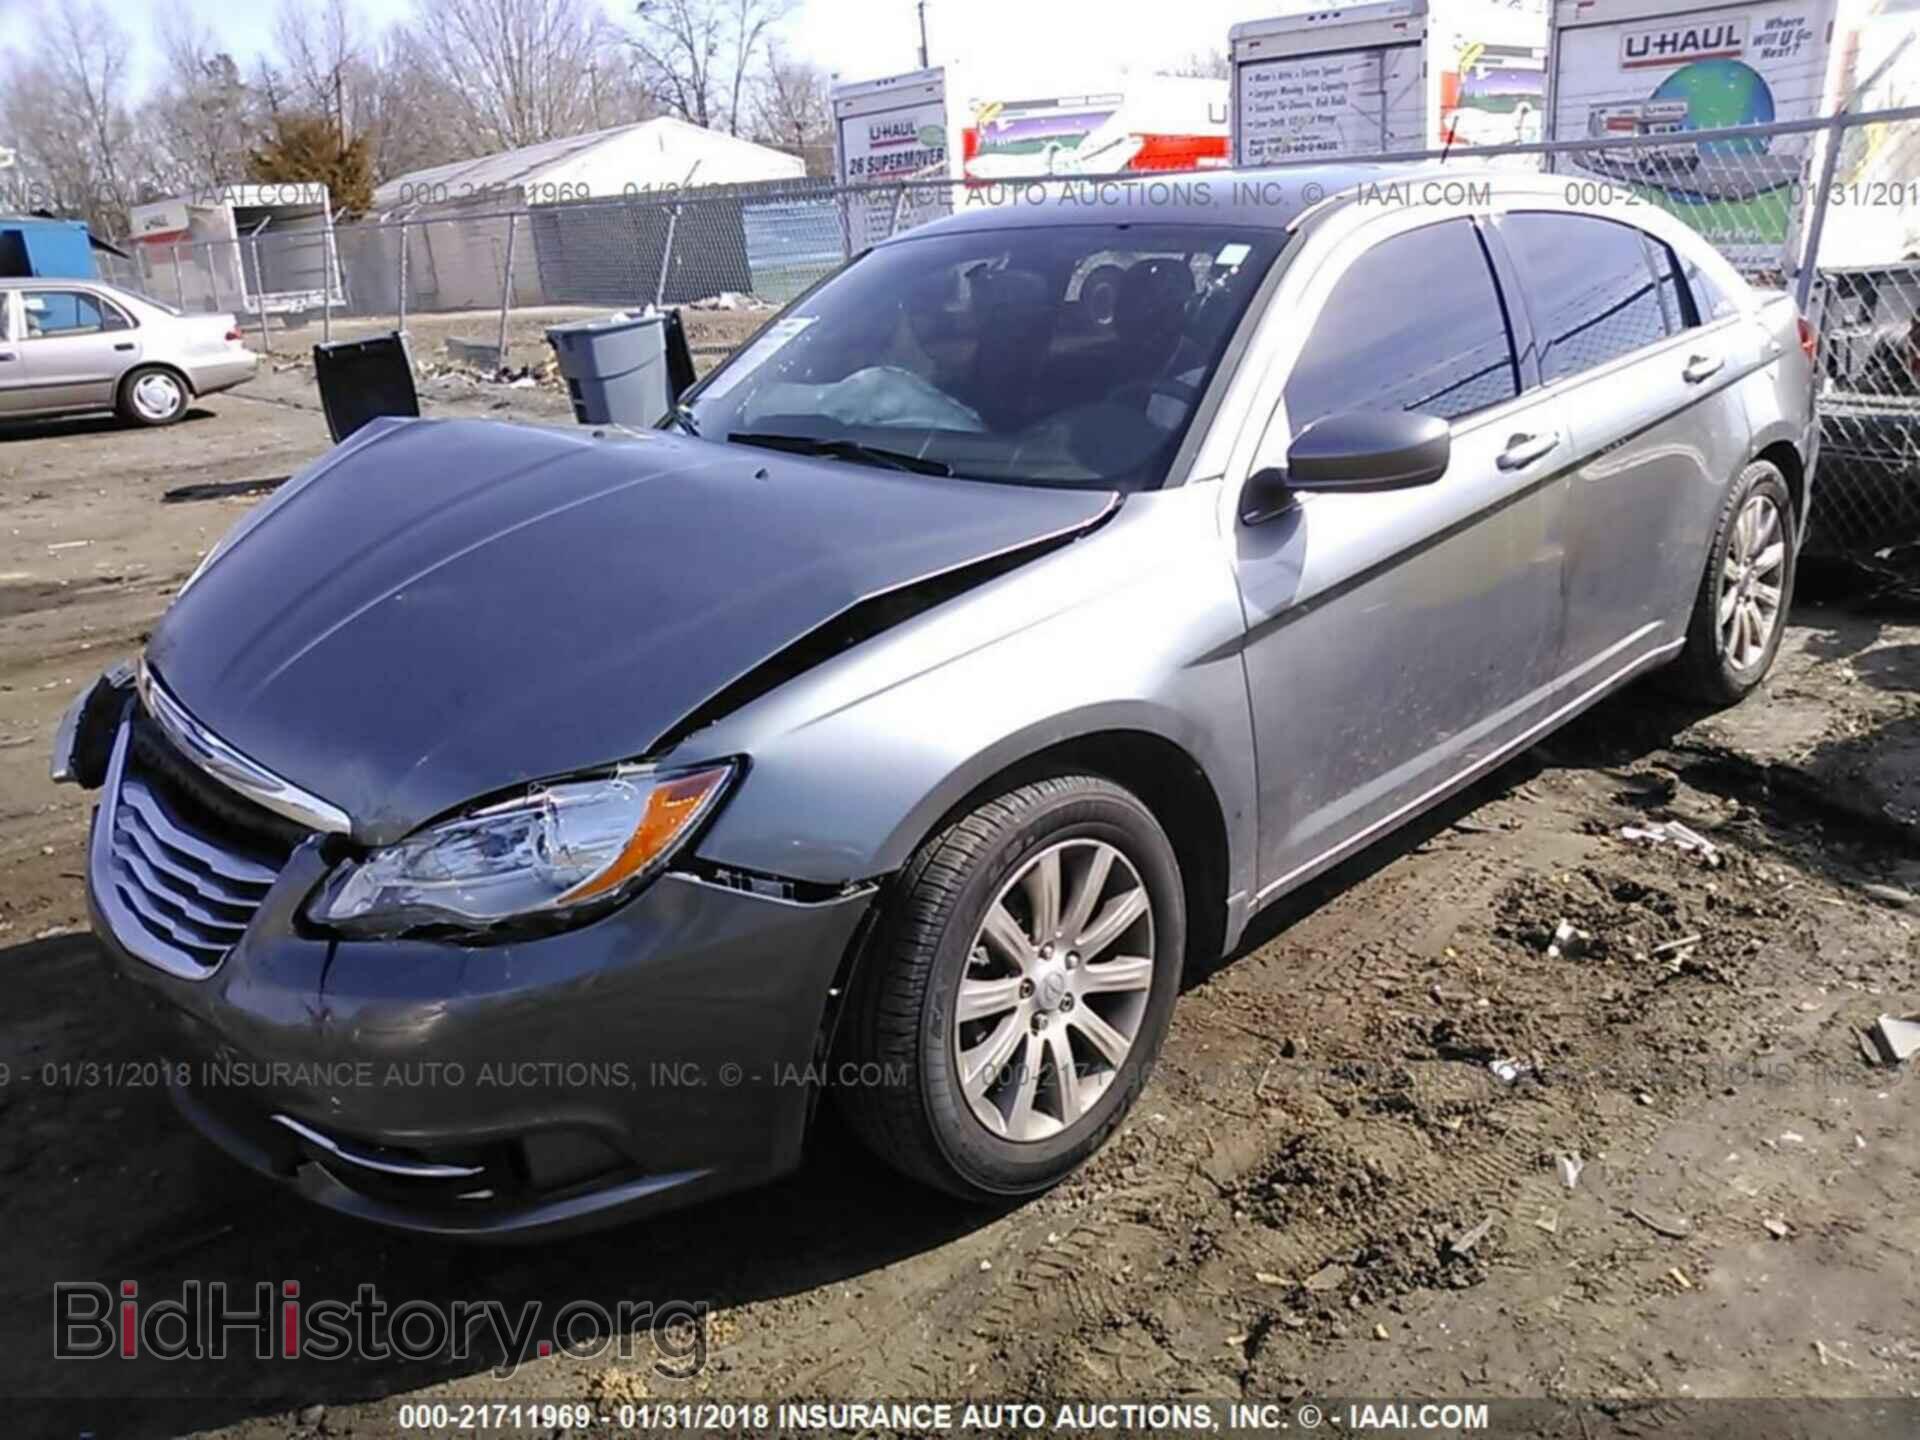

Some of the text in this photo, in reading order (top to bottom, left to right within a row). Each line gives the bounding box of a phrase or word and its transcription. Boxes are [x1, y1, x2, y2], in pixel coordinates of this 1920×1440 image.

[1765, 16, 1805, 31] Where
[1626, 24, 1742, 57] U-HAUL
[1780, 29, 1794, 47] U
[870, 122, 916, 141] U-HAUL
